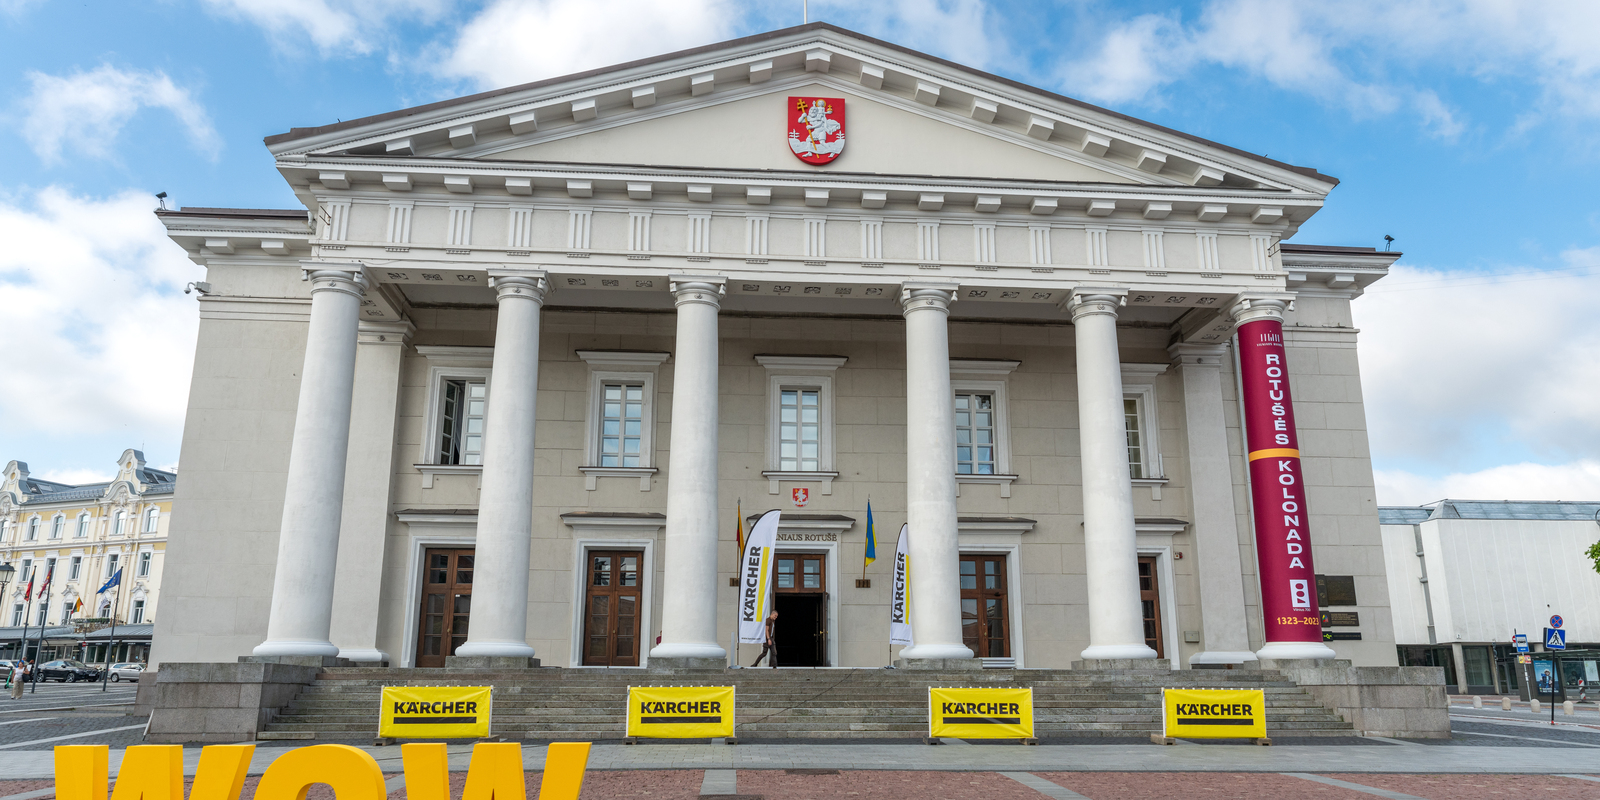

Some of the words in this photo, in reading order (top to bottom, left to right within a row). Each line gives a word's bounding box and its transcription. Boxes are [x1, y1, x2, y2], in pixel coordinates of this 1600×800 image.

[1265, 353, 1290, 446] ROTUŠĖS
[1278, 460, 1306, 569] KOLONADA
[776, 533, 803, 541] NIAUS
[805, 533, 838, 541] ROTUŠĖ
[743, 546, 762, 622] KÄRCHER
[892, 552, 905, 624] KÄRCHER
[394, 701, 477, 714] KÄRCHER
[640, 701, 721, 714] KÄRCHER
[942, 702, 1020, 715] KÄRCHER
[1176, 703, 1253, 716] KÄRCHER
